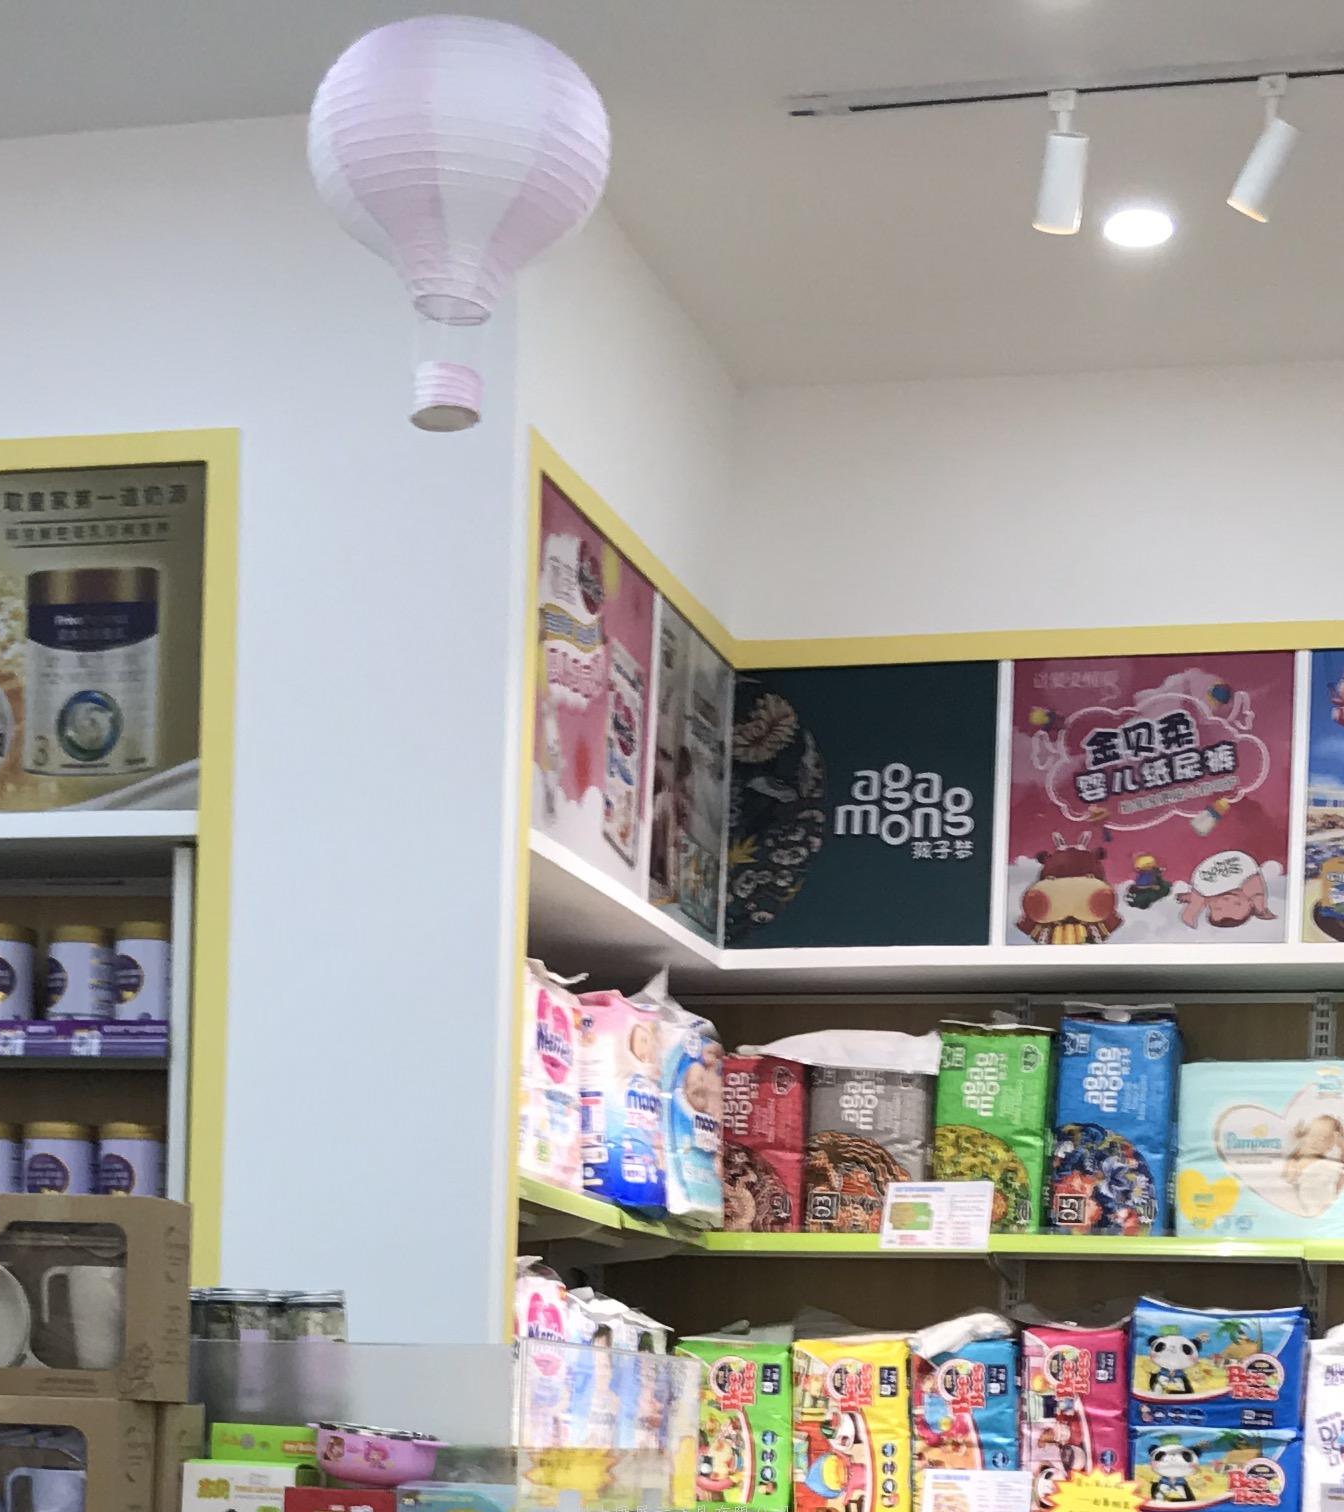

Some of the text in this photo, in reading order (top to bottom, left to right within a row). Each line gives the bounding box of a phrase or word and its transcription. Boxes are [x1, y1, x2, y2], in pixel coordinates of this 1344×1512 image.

[1083, 712, 1196, 769] 金贝柔
[1074, 740, 1238, 802] 婴儿纸尿裤
